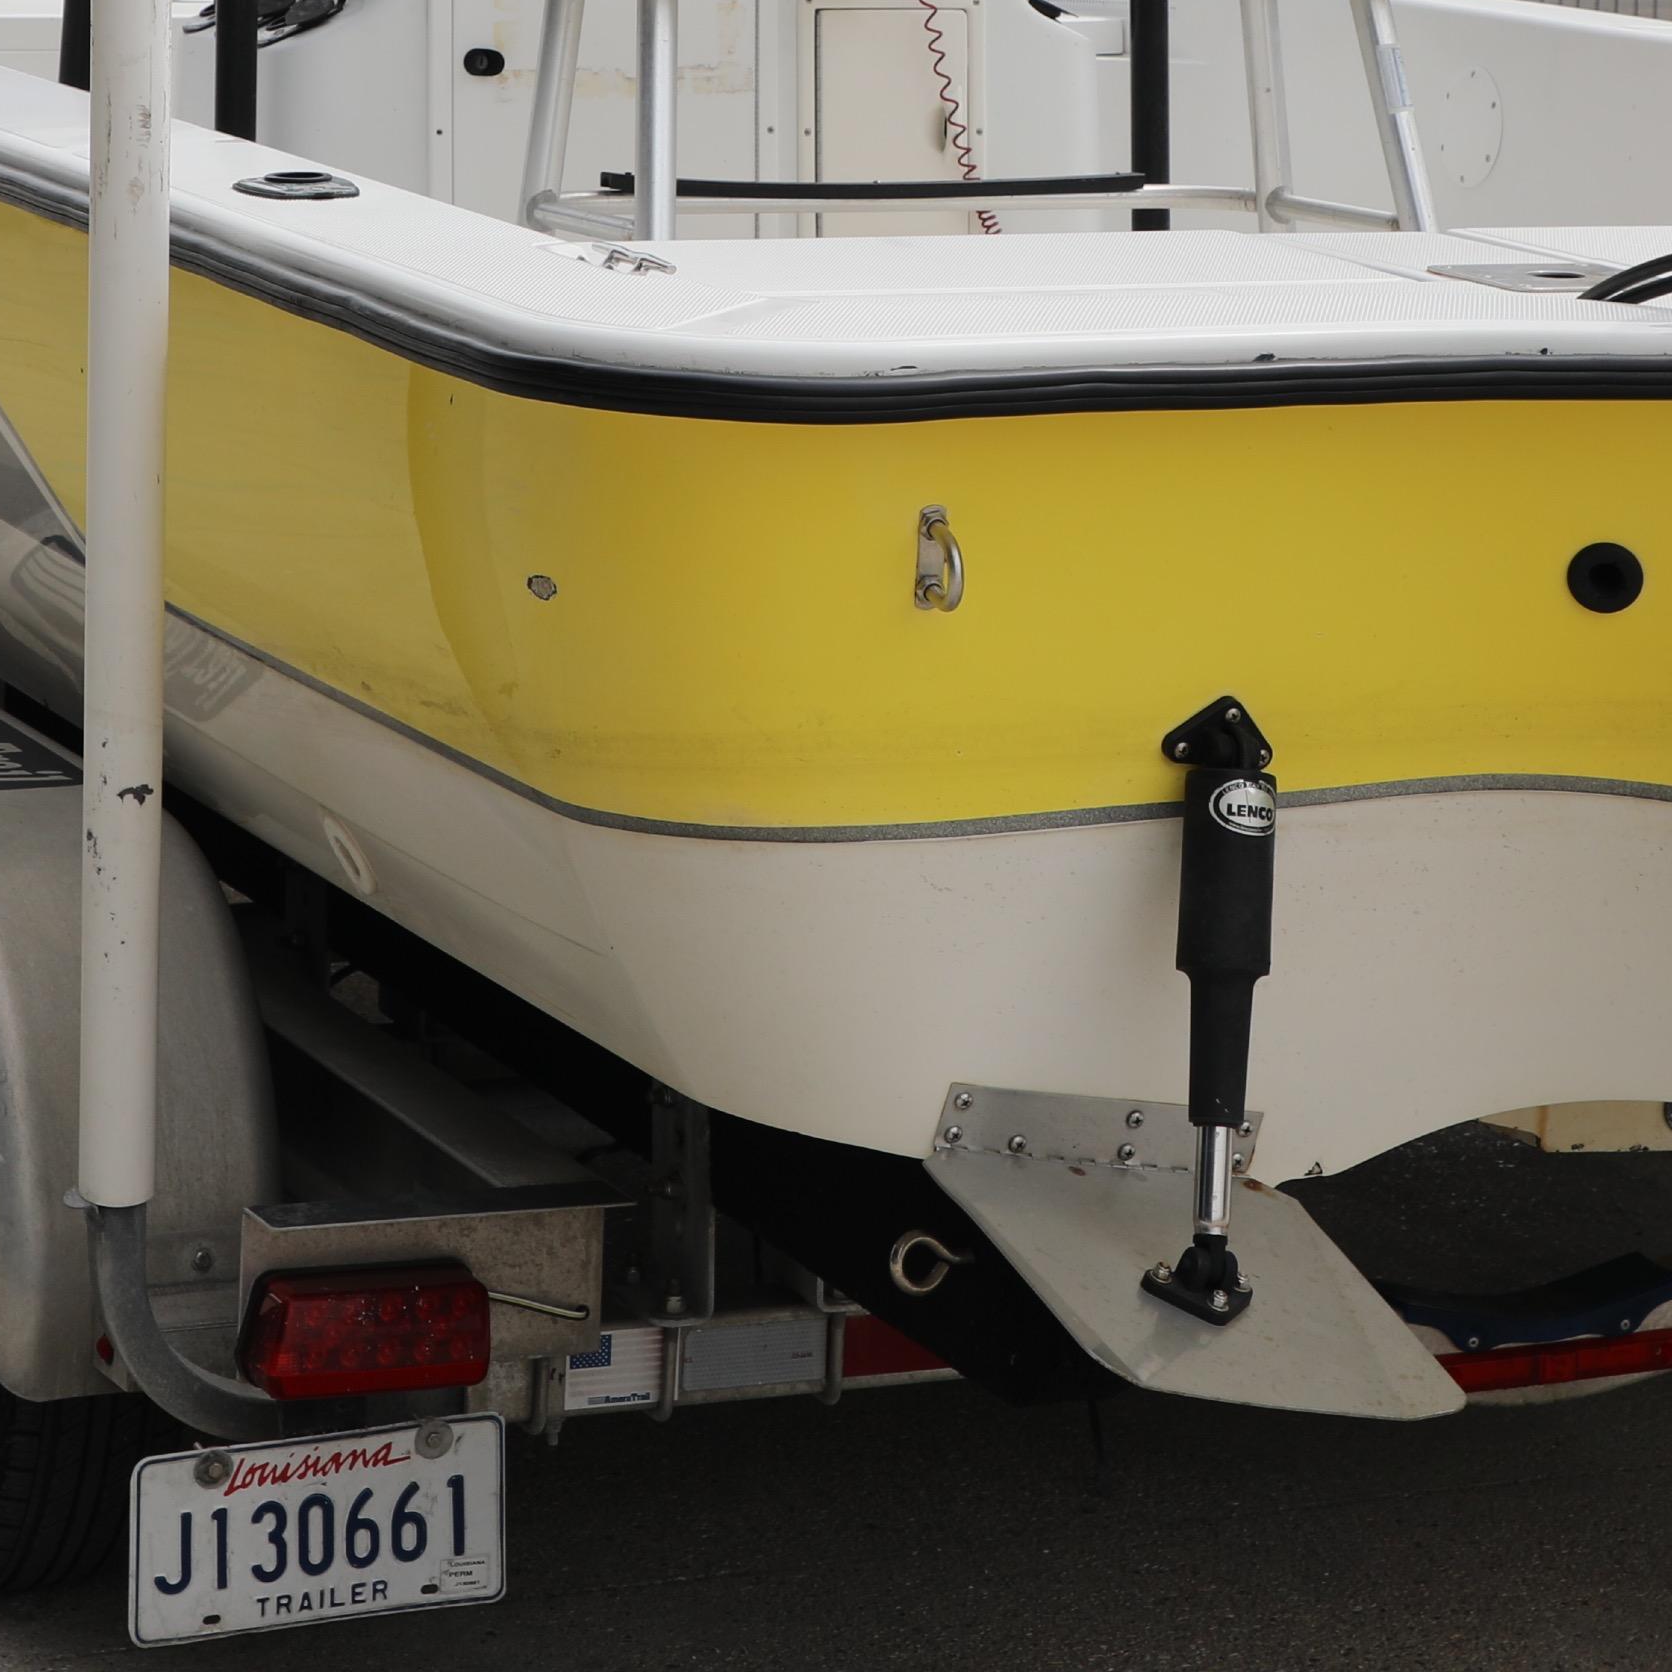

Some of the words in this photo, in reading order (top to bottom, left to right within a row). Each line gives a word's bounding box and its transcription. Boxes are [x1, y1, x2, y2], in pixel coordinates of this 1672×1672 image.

[1226, 803, 1274, 822] LENCO
[224, 1441, 411, 1497] Louisiana
[153, 1474, 466, 1596] J130661
[256, 1580, 389, 1618] TRAILER
